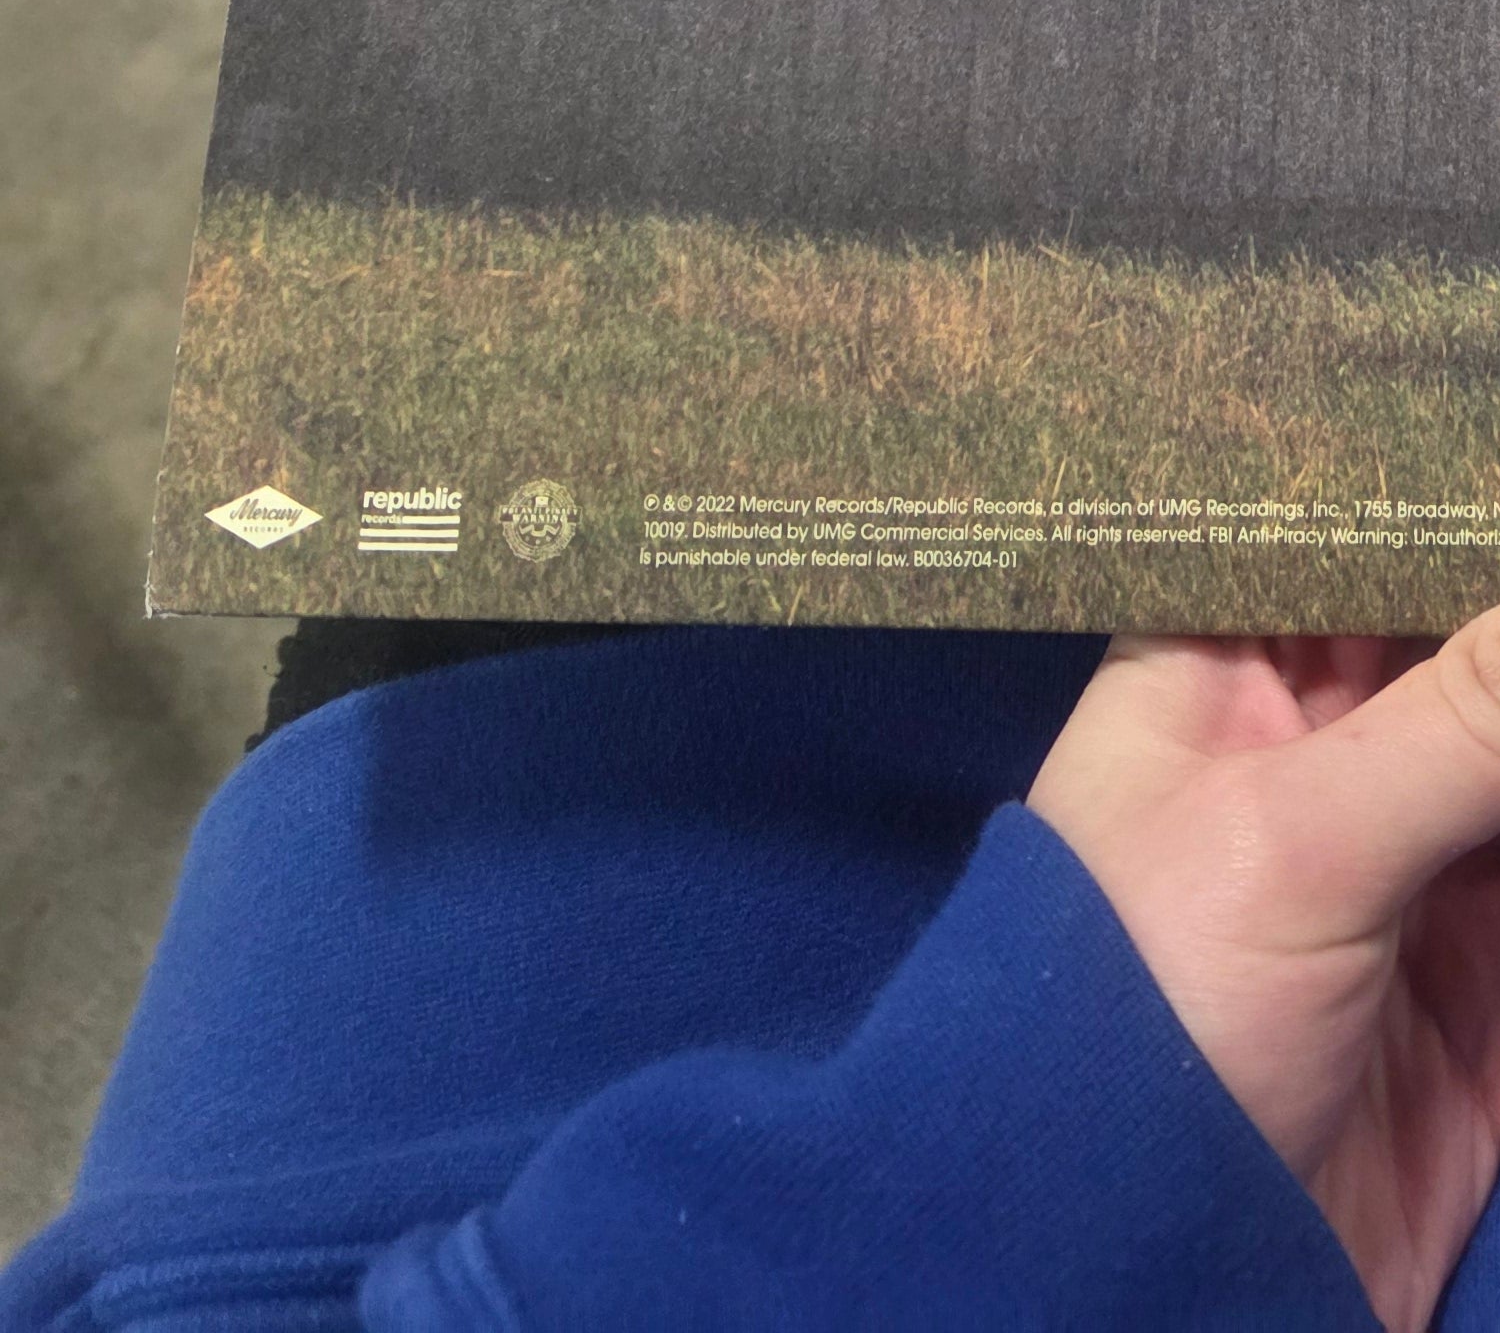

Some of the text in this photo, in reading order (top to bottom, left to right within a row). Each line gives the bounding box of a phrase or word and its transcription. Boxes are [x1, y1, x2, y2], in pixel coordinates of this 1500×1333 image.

[229, 498, 303, 527] Mercury
[363, 487, 463, 513] republic
[696, 496, 735, 512] 2022
[740, 496, 811, 516] Mercury
[816, 497, 968, 517] Records/Republic
[973, 497, 1047, 517] Records,
[1050, 503, 1063, 515] a
[1068, 498, 1132, 516] division
[1137, 499, 1154, 516] of
[1159, 499, 1201, 516] UMG
[1207, 499, 1308, 521] Recordings,
[1354, 501, 1392, 518] 1755
[1397, 501, 1488, 522] Broadway,
[361, 514, 402, 523] records
[644, 521, 688, 539] 10019.
[692, 522, 782, 539] Distributed
[787, 523, 808, 543] by
[813, 523, 856, 540] UMG
[861, 523, 969, 541] Commercial
[973, 524, 1048, 541] Services.
[1051, 524, 1071, 541] All
[1076, 525, 1122, 546] rights
[1126, 527, 1205, 543] reserved.
[1209, 527, 1232, 543] FBI
[1237, 526, 1326, 548] Anti-Piracy
[1331, 528, 1408, 549] Warning:
[655, 548, 751, 568] punishable
[755, 549, 806, 566] under
[811, 549, 872, 567] federal
[876, 550, 909, 568] law.
[914, 550, 1017, 568] B0036704-01
